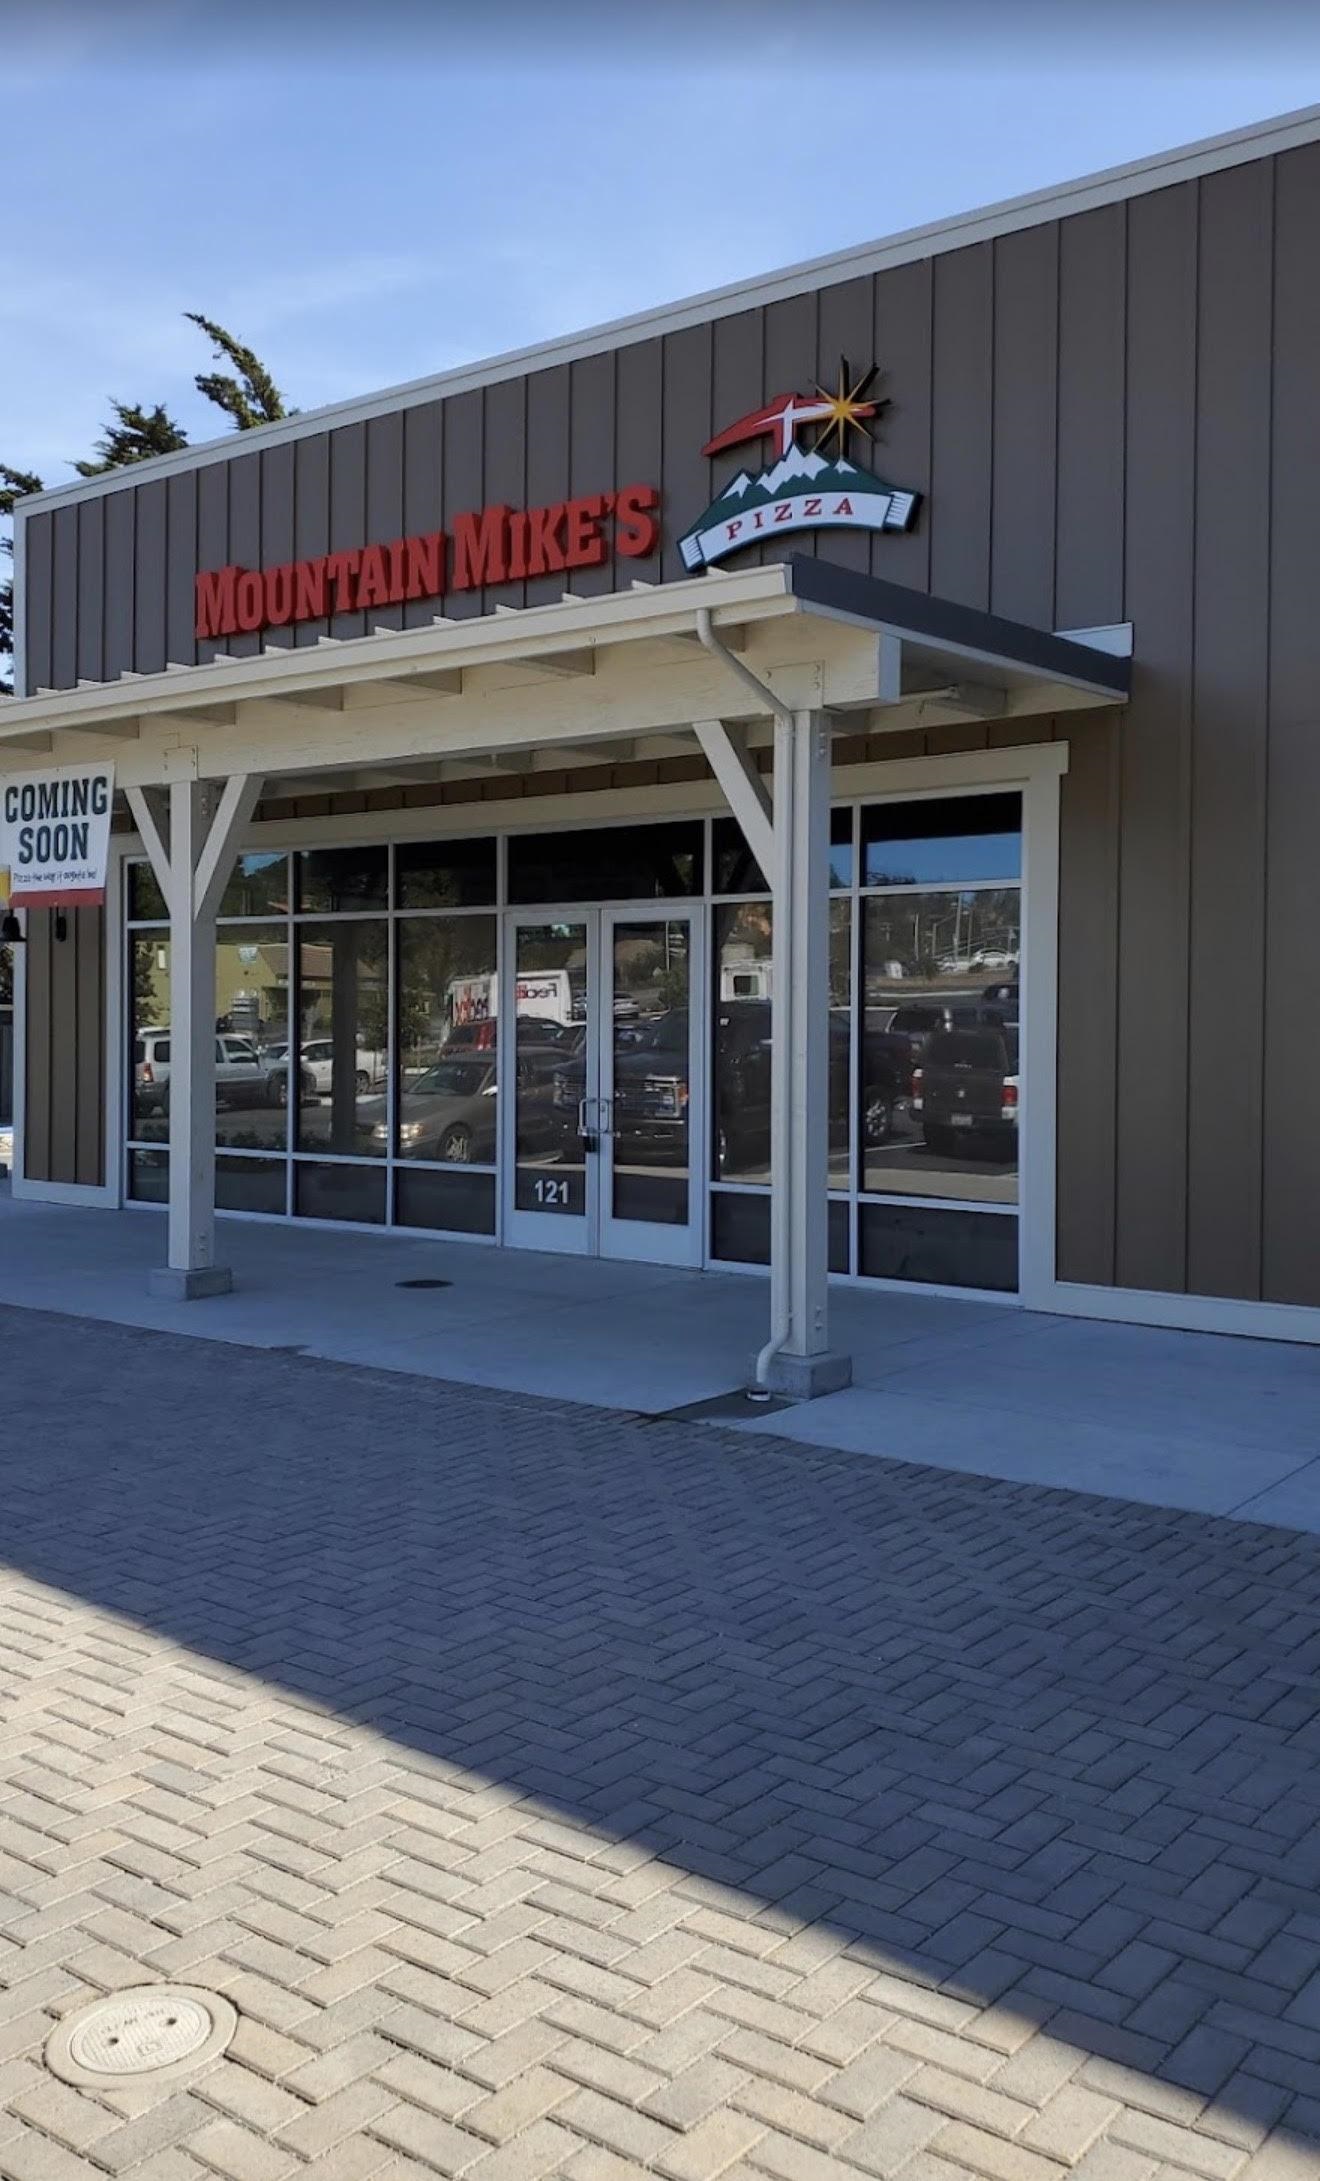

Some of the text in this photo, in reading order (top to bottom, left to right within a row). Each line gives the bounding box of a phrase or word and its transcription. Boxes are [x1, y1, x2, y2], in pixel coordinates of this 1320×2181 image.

[726, 498, 855, 541] PIZZA
[194, 481, 659, 640] MOUNTAIN MIKE'S
[5, 776, 107, 823] COMING
[18, 822, 89, 864] SOON
[534, 1179, 569, 1205] 121
